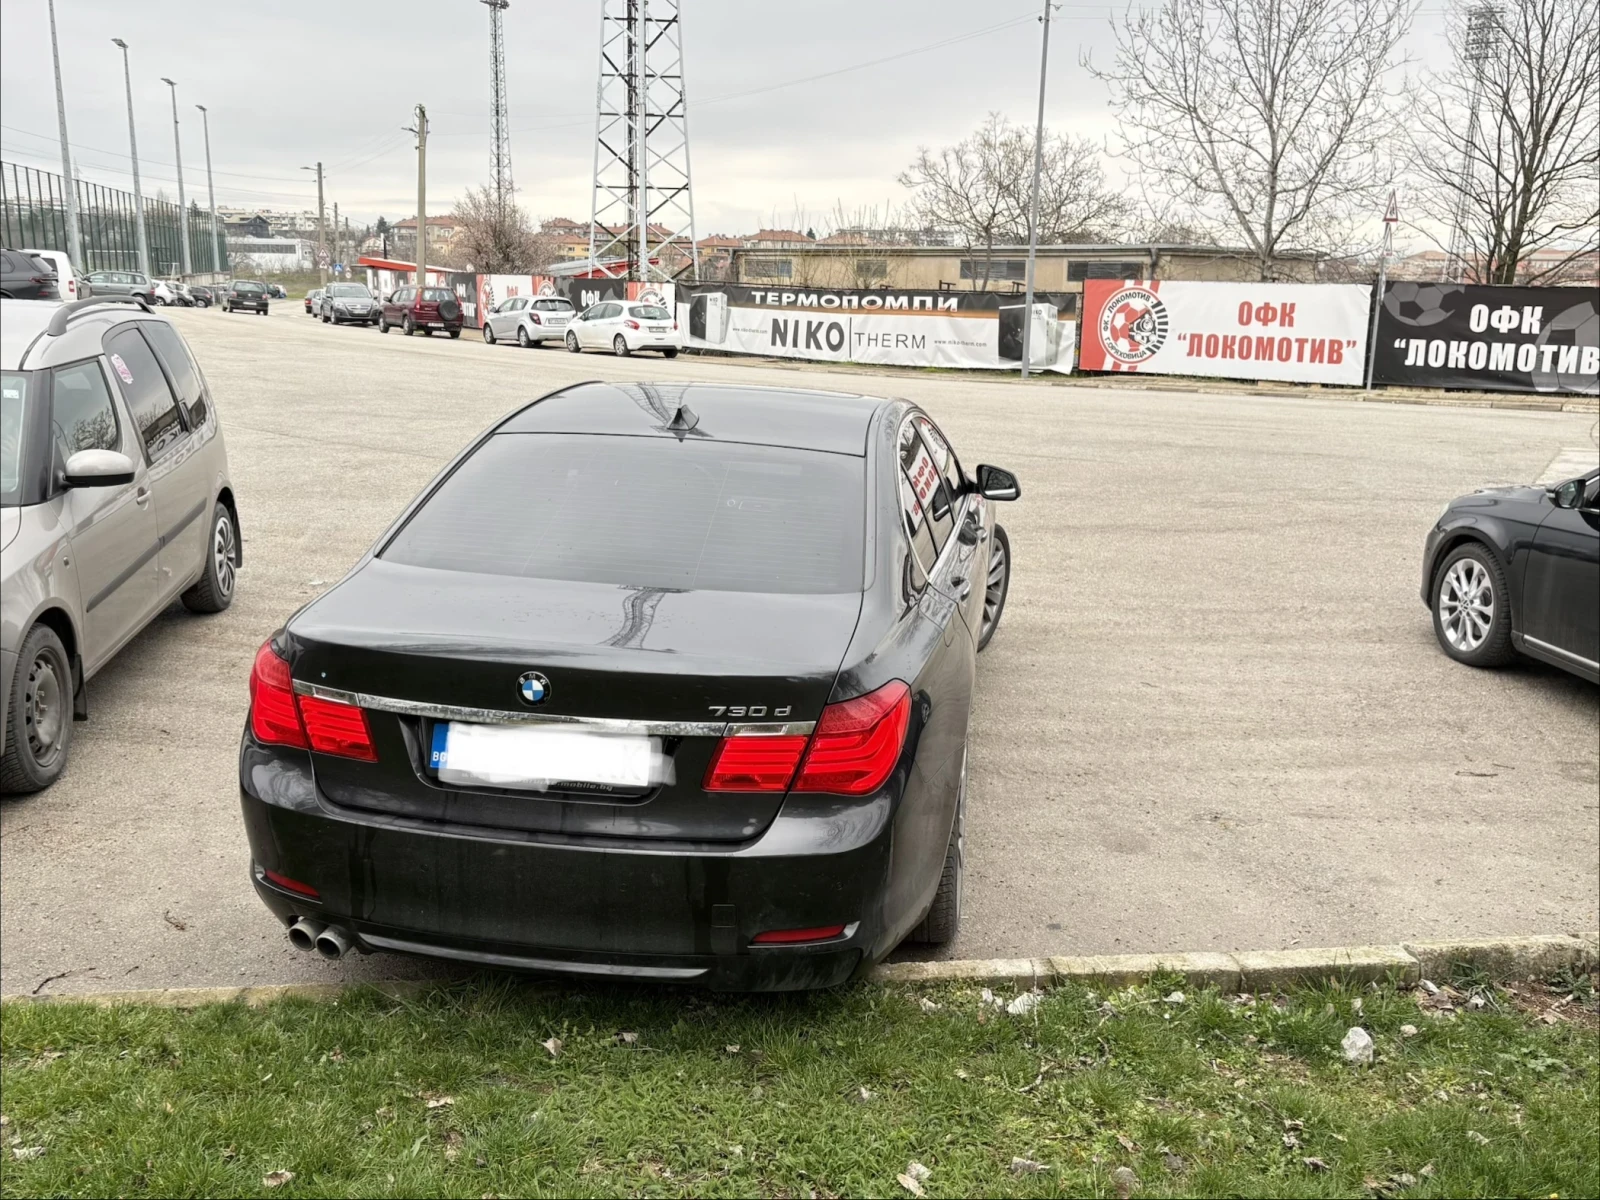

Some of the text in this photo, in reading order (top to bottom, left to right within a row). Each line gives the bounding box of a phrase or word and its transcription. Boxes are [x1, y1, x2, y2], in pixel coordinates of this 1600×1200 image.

[751, 291, 958, 312] ТЕРМОПОМПИ
[1107, 291, 1151, 314] ЛОКОМОТИВ
[1237, 301, 1297, 328] ОФК
[1469, 303, 1544, 335] ОФК
[770, 318, 926, 353] NIKO THERM
[518, 672, 548, 685] BMW
[708, 705, 792, 717] 730 d
[432, 750, 447, 762] BG
